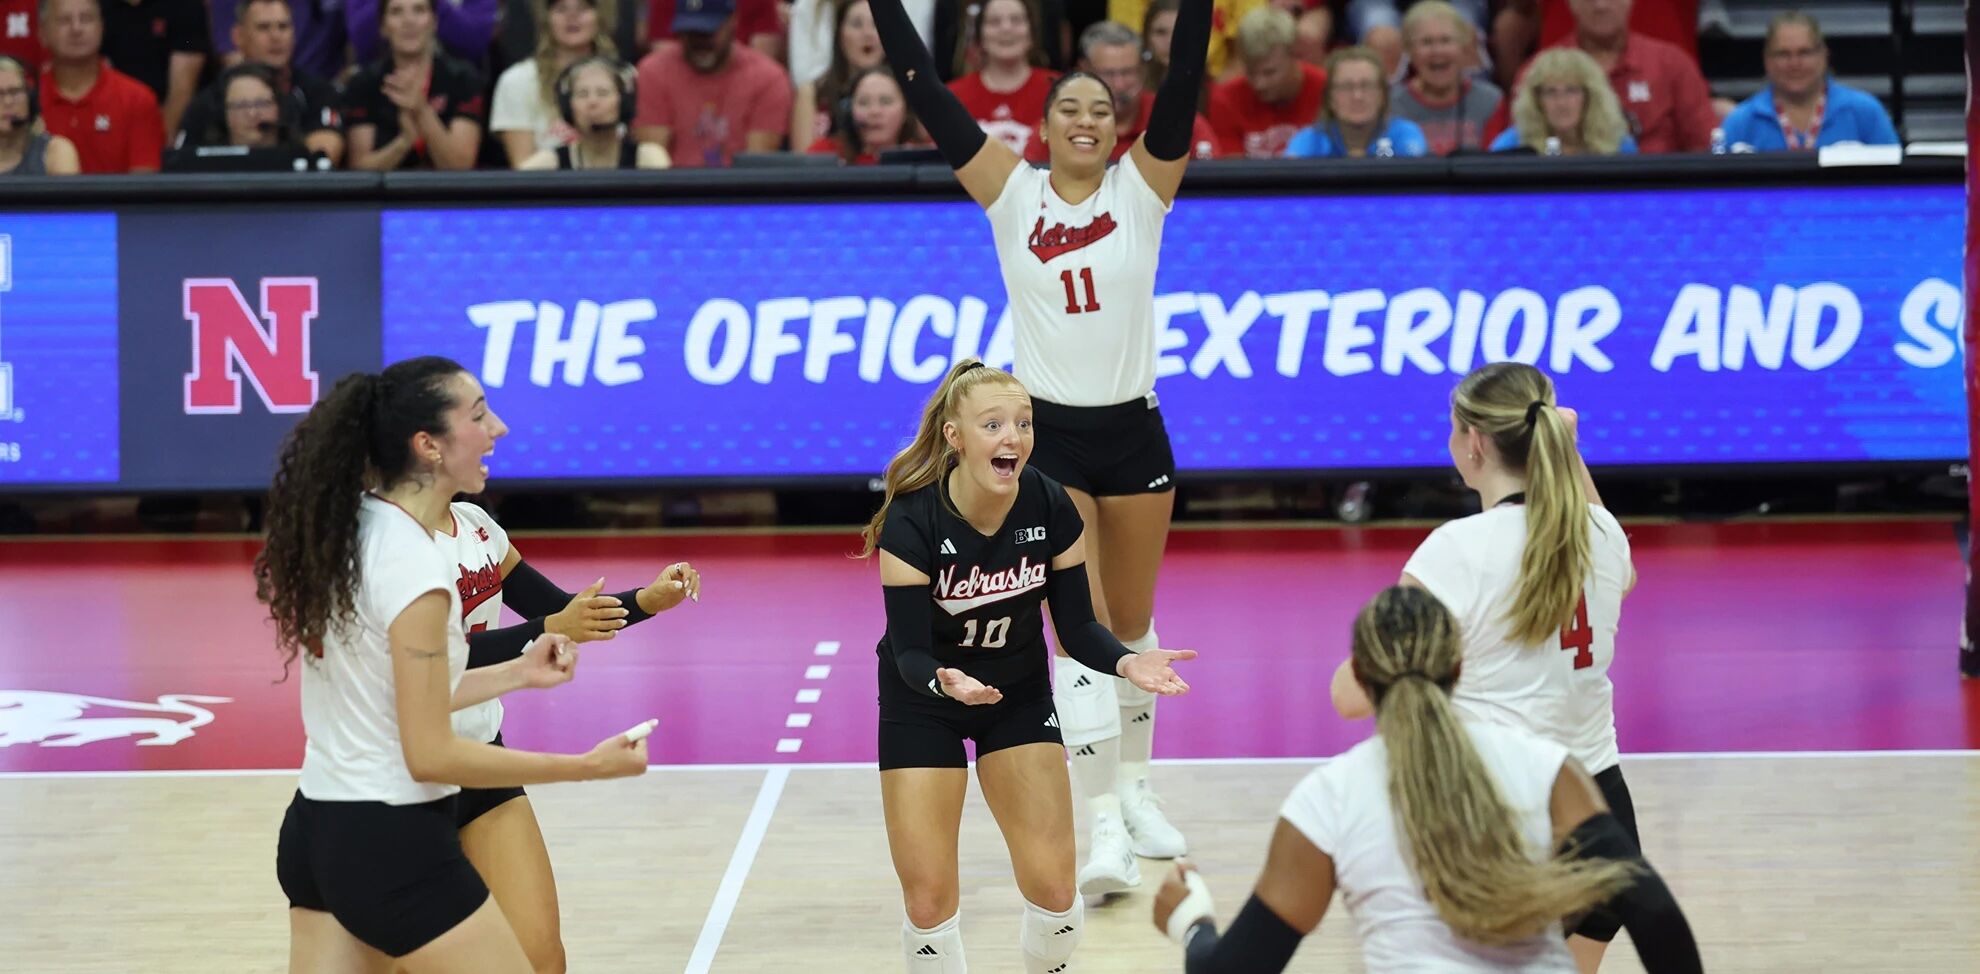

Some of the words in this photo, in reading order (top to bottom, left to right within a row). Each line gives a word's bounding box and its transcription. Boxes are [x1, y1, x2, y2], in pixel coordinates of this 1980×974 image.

[1060, 267, 1101, 314] 11
[183, 277, 319, 415] N
[466, 297, 658, 388] THE
[1153, 285, 1623, 378] EXTERIOR
[1651, 281, 1864, 373] AND
[1893, 277, 1965, 368] S
[932, 556, 1047, 606] Nebraska
[958, 616, 1012, 648] 10
[1559, 586, 1593, 670] 4
